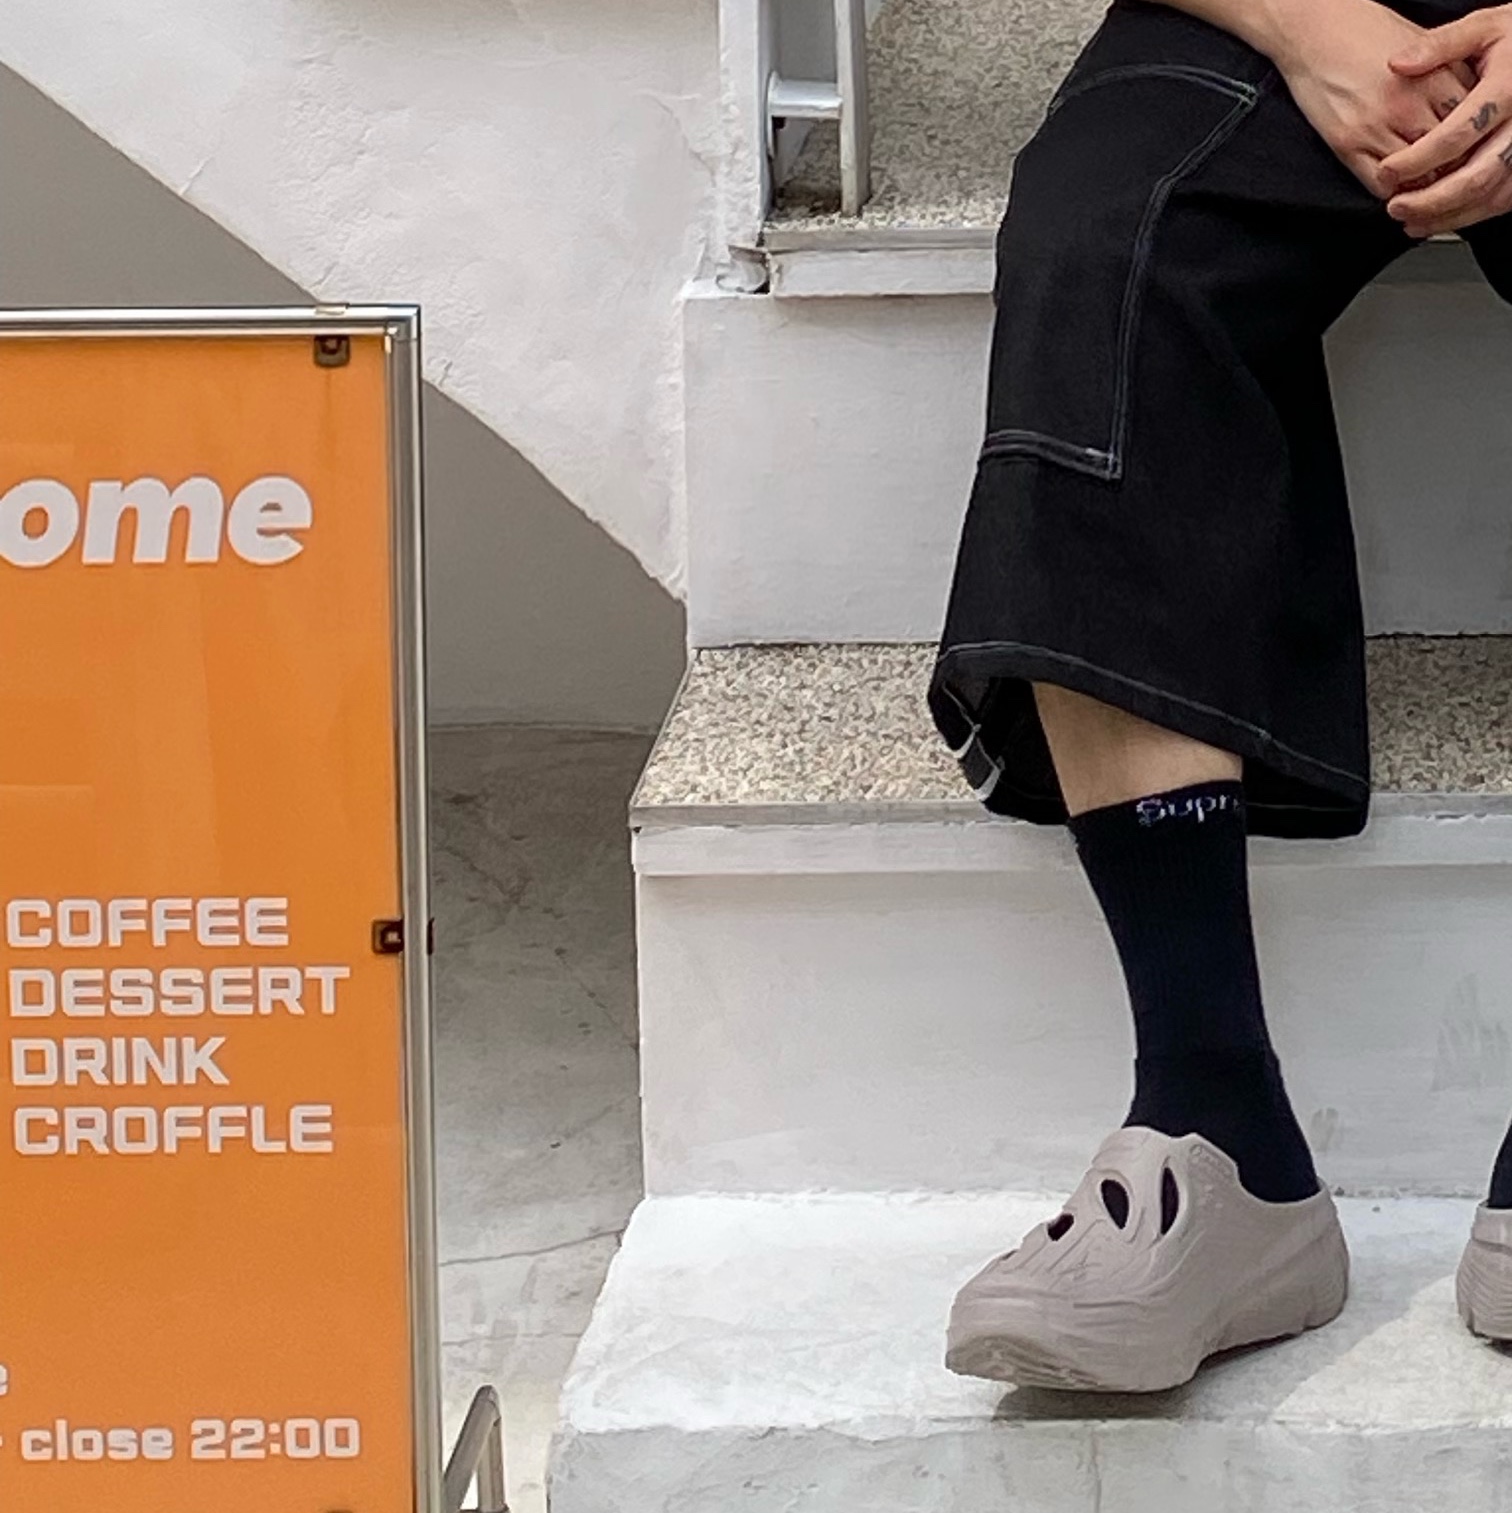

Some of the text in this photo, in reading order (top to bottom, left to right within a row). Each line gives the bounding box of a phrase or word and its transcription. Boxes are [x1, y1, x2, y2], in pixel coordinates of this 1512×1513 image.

[0, 476, 313, 568] ome
[6, 897, 289, 948] COFFEE
[9, 966, 351, 1017] DESSERT
[11, 1037, 230, 1086] DRINK
[14, 1105, 334, 1155] CROFFLE
[21, 1418, 360, 1461] close 22:00
